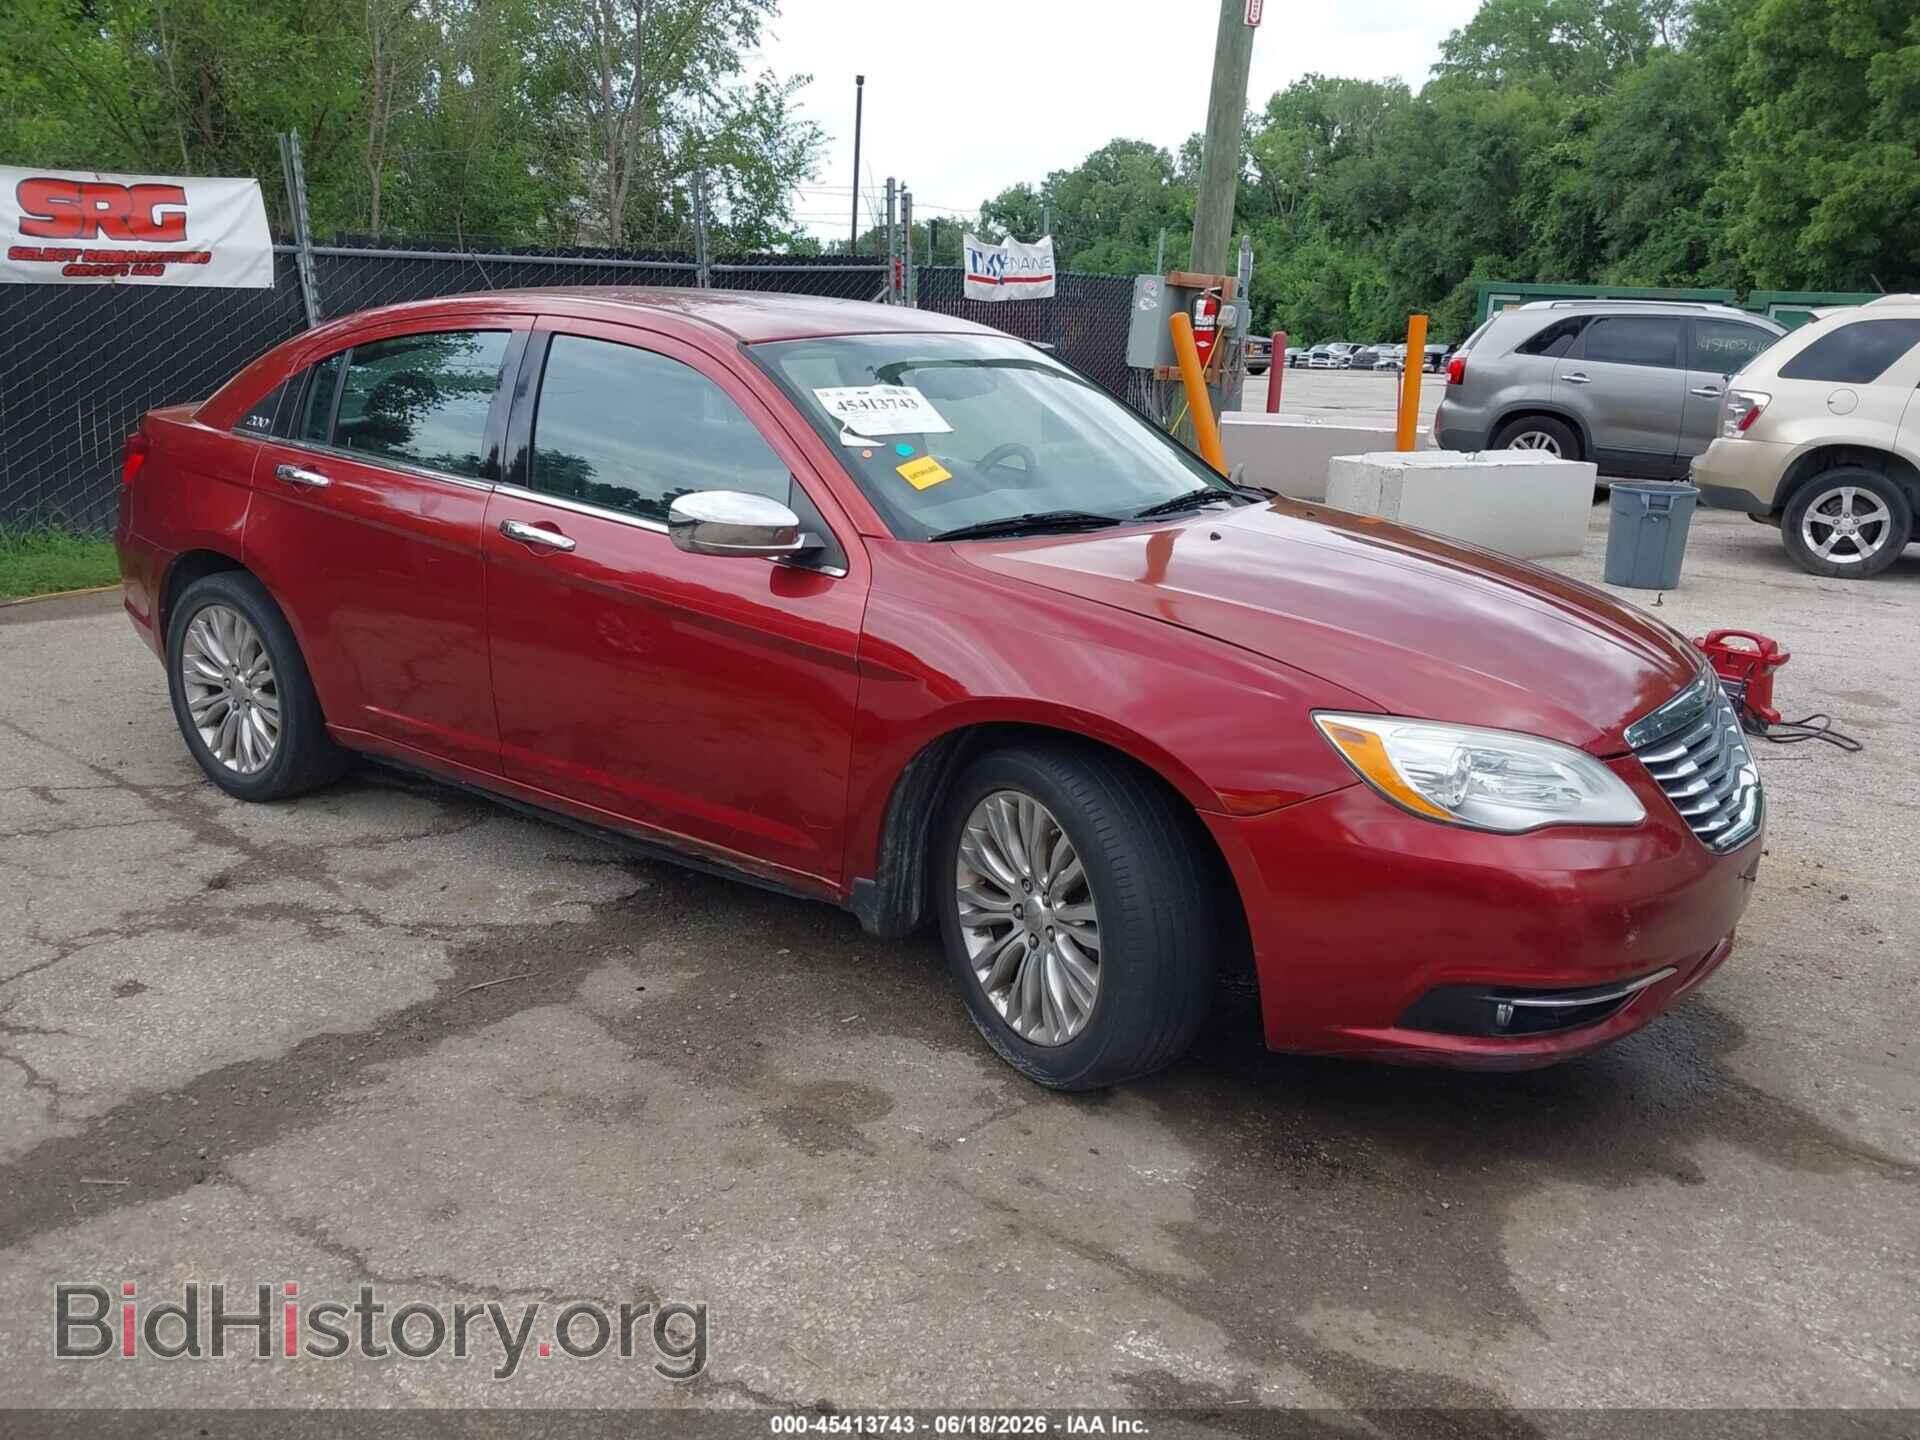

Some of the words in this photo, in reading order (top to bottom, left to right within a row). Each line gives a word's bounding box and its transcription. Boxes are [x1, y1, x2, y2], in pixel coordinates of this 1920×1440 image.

[16, 177, 188, 243] SRG
[8, 246, 82, 261] SELECT
[836, 398, 920, 412] 45413743
